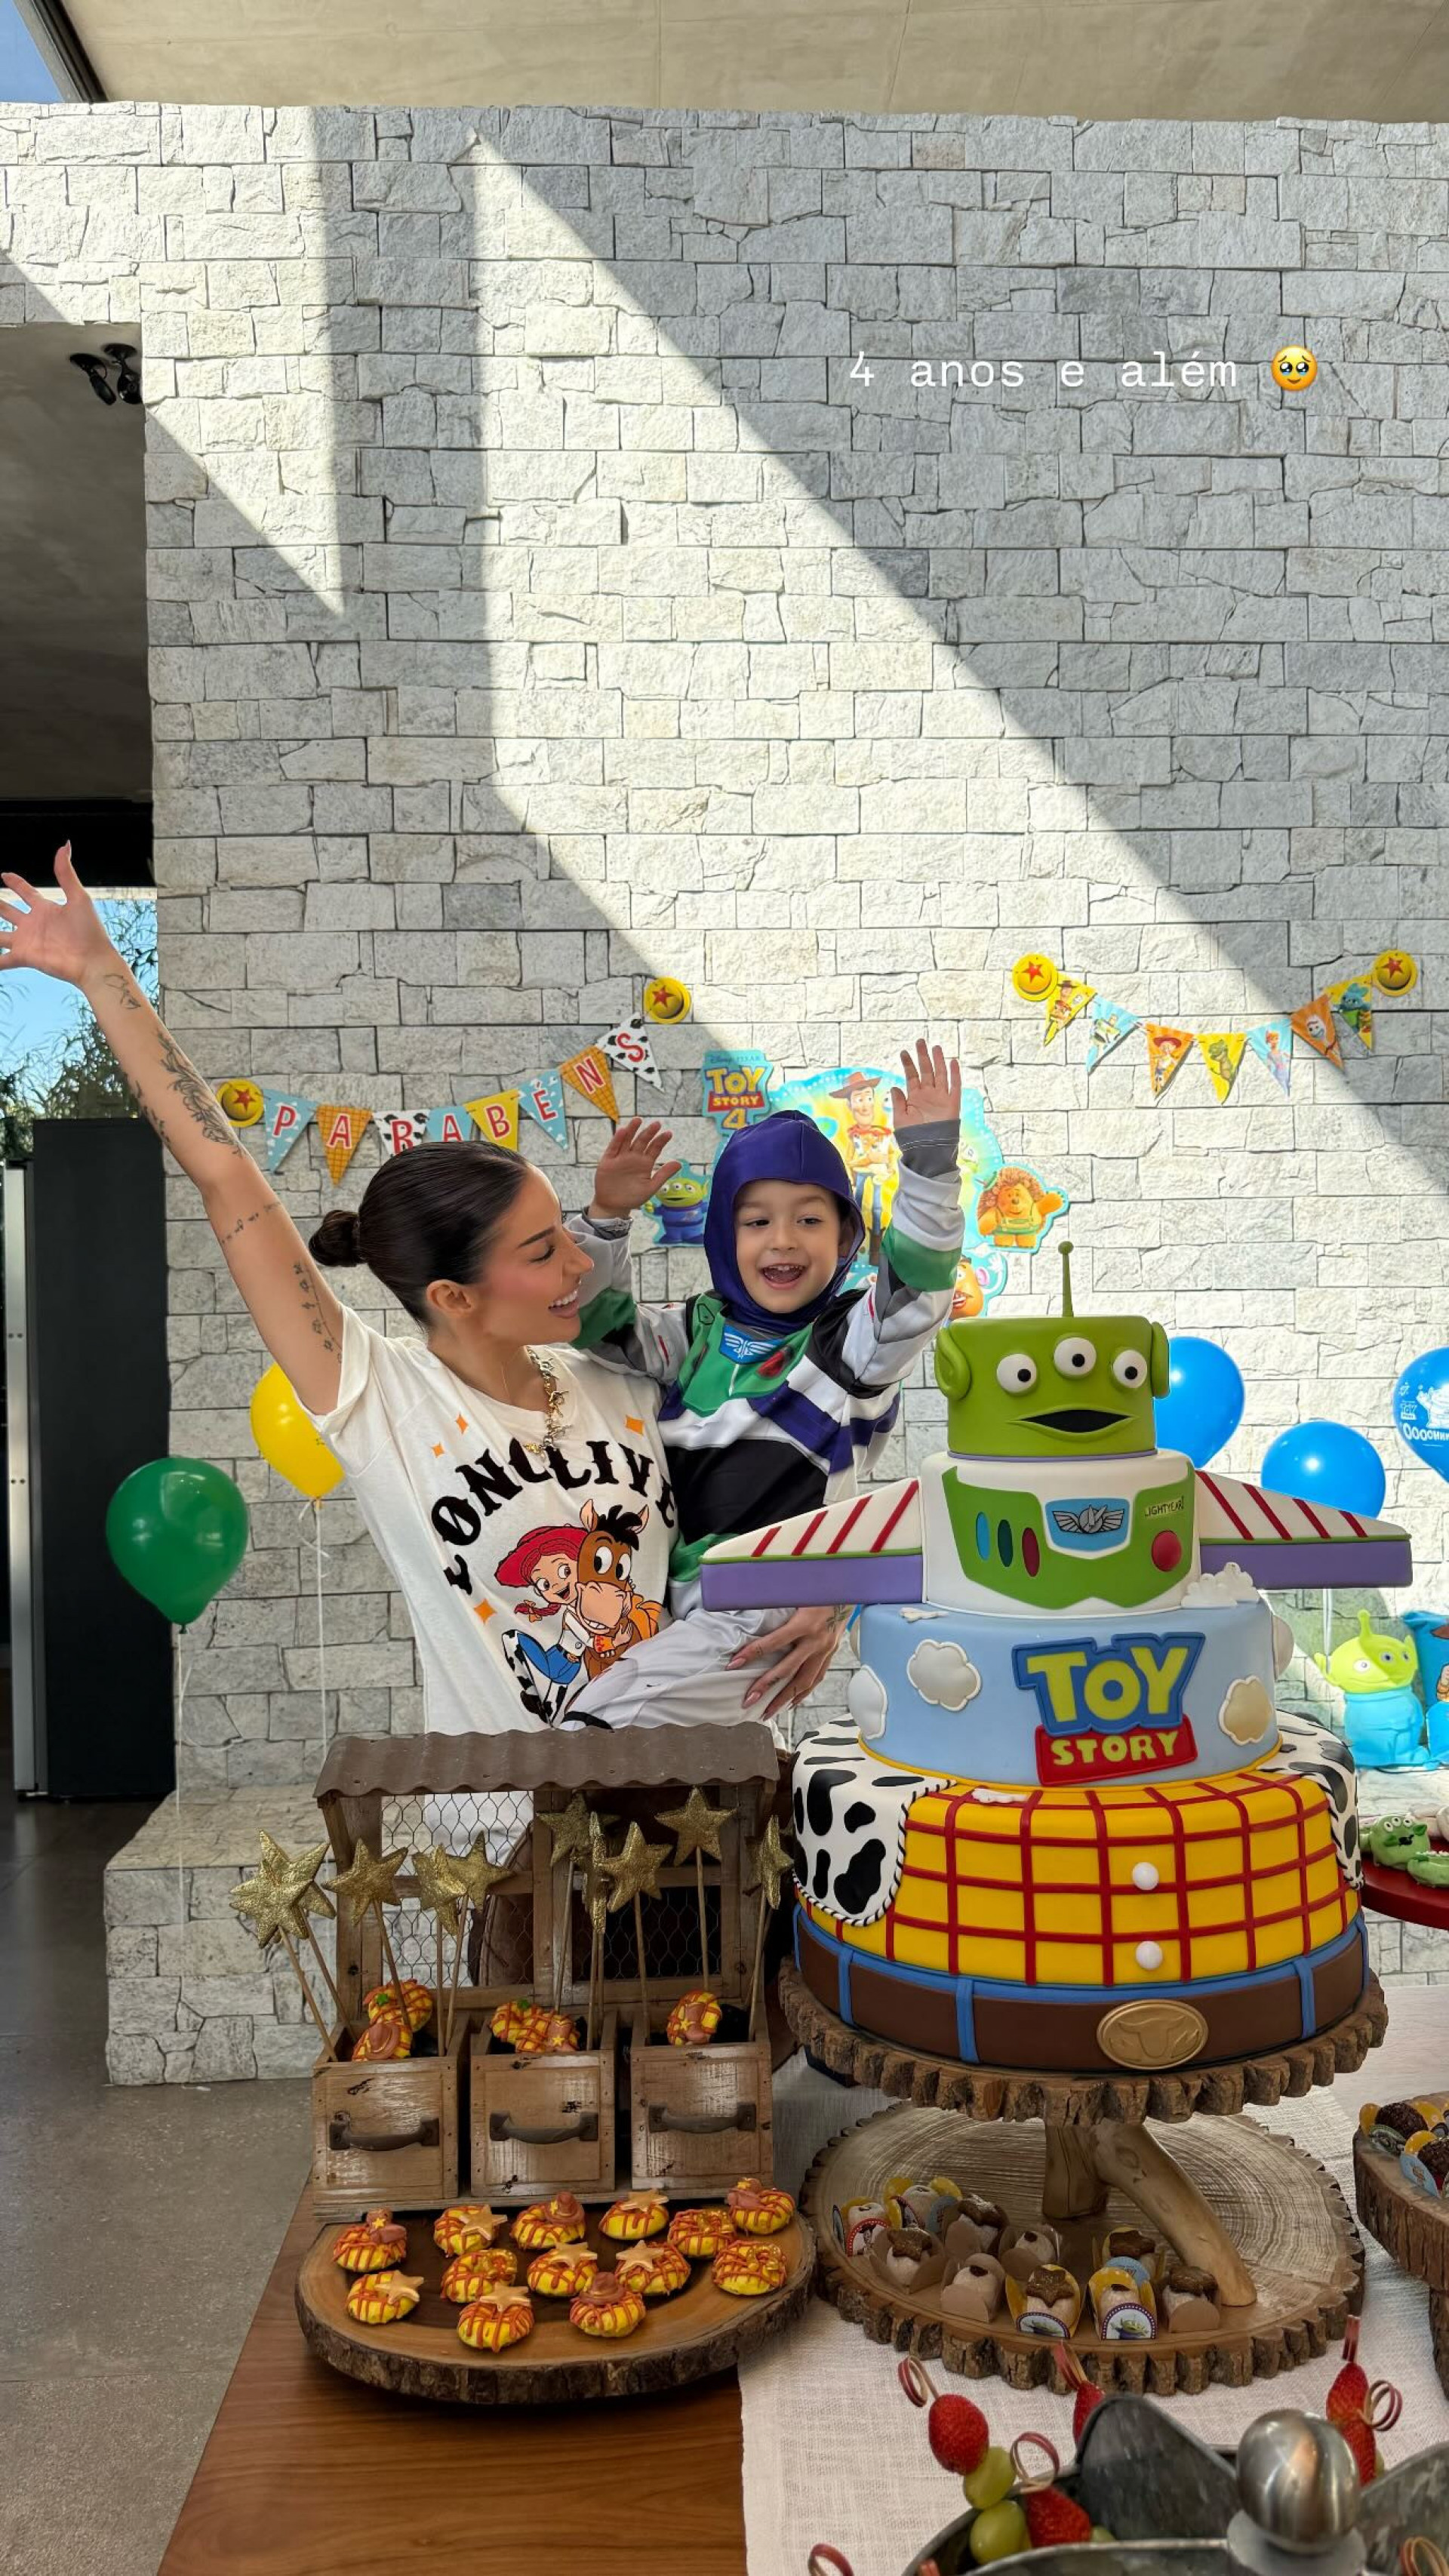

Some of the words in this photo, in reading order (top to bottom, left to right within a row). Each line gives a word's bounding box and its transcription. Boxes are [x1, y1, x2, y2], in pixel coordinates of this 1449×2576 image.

[272, 1032, 644, 1154] PARABÉNS
[706, 1066, 766, 1094] TOY
[712, 1096, 759, 1106] STORY
[722, 1107, 747, 1130] 4
[1026, 1647, 1189, 1722] TOY
[1051, 1731, 1179, 1766] STORY
